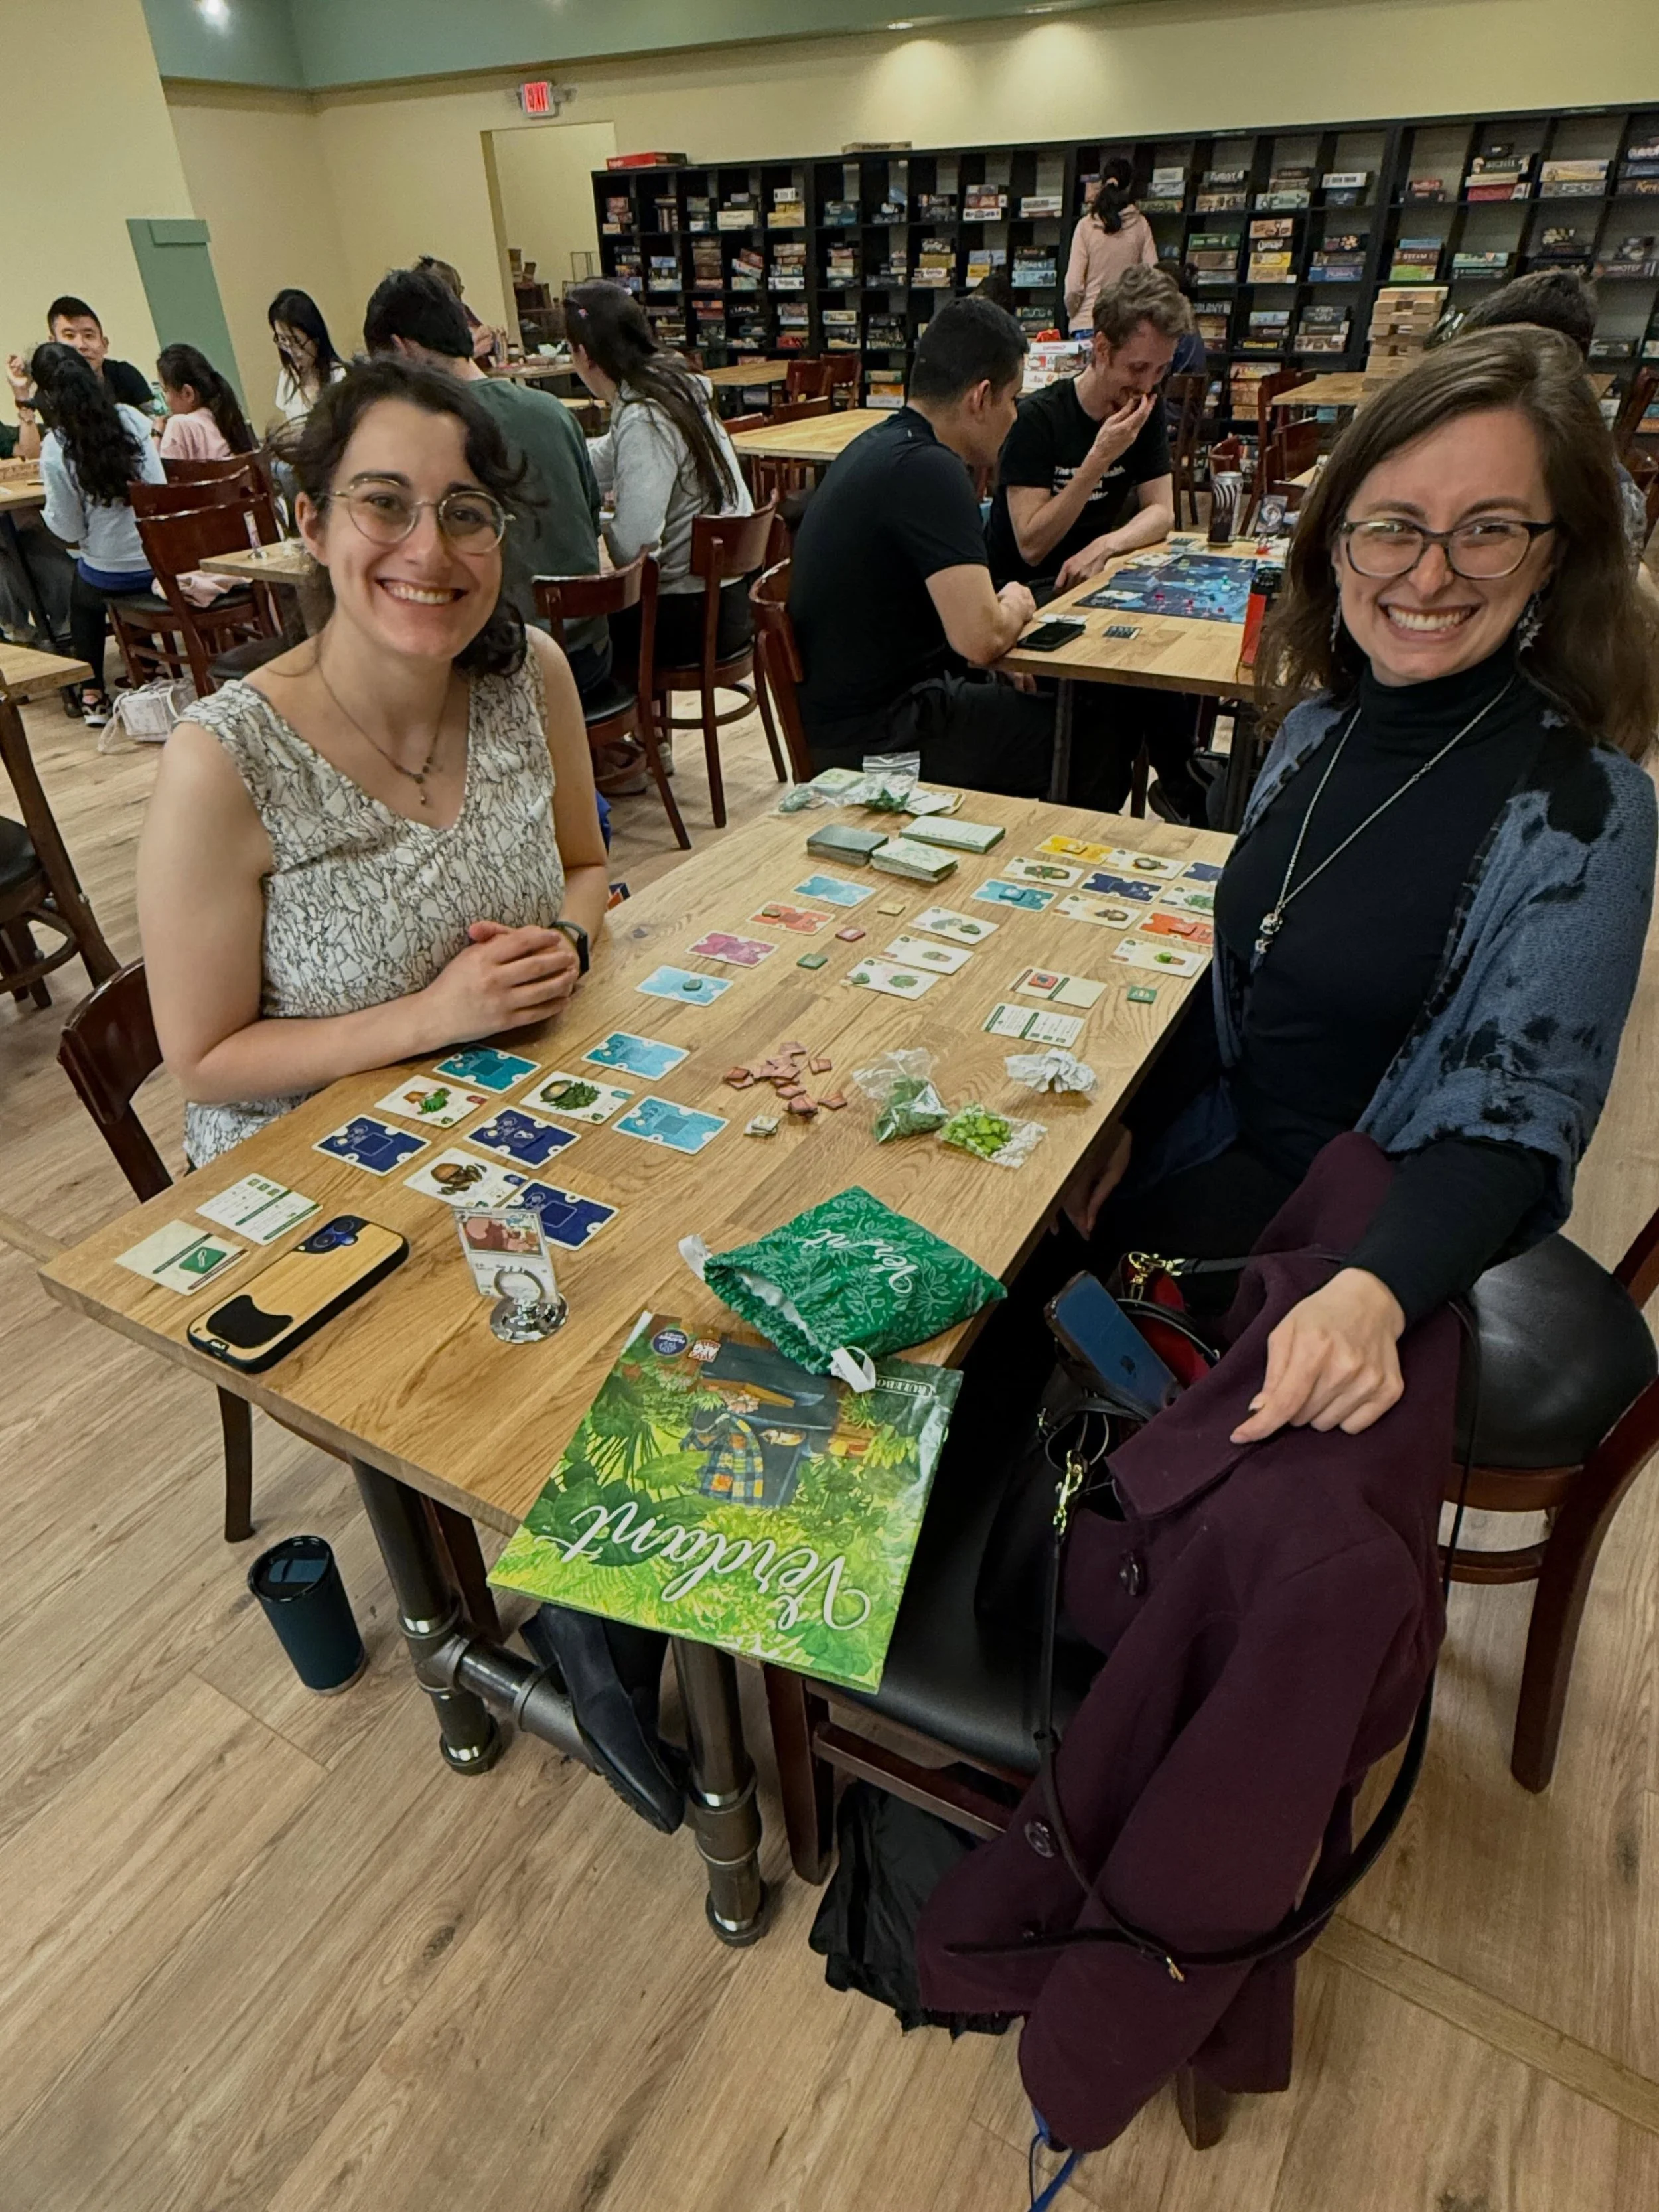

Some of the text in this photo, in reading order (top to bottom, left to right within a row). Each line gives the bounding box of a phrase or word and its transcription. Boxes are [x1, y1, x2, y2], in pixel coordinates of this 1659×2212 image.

[525, 82, 549, 112] EXIT
[794, 1229, 918, 1293] Vernt
[876, 1378, 928, 1396] RULEBO
[534, 1501, 872, 1631] Verdant
